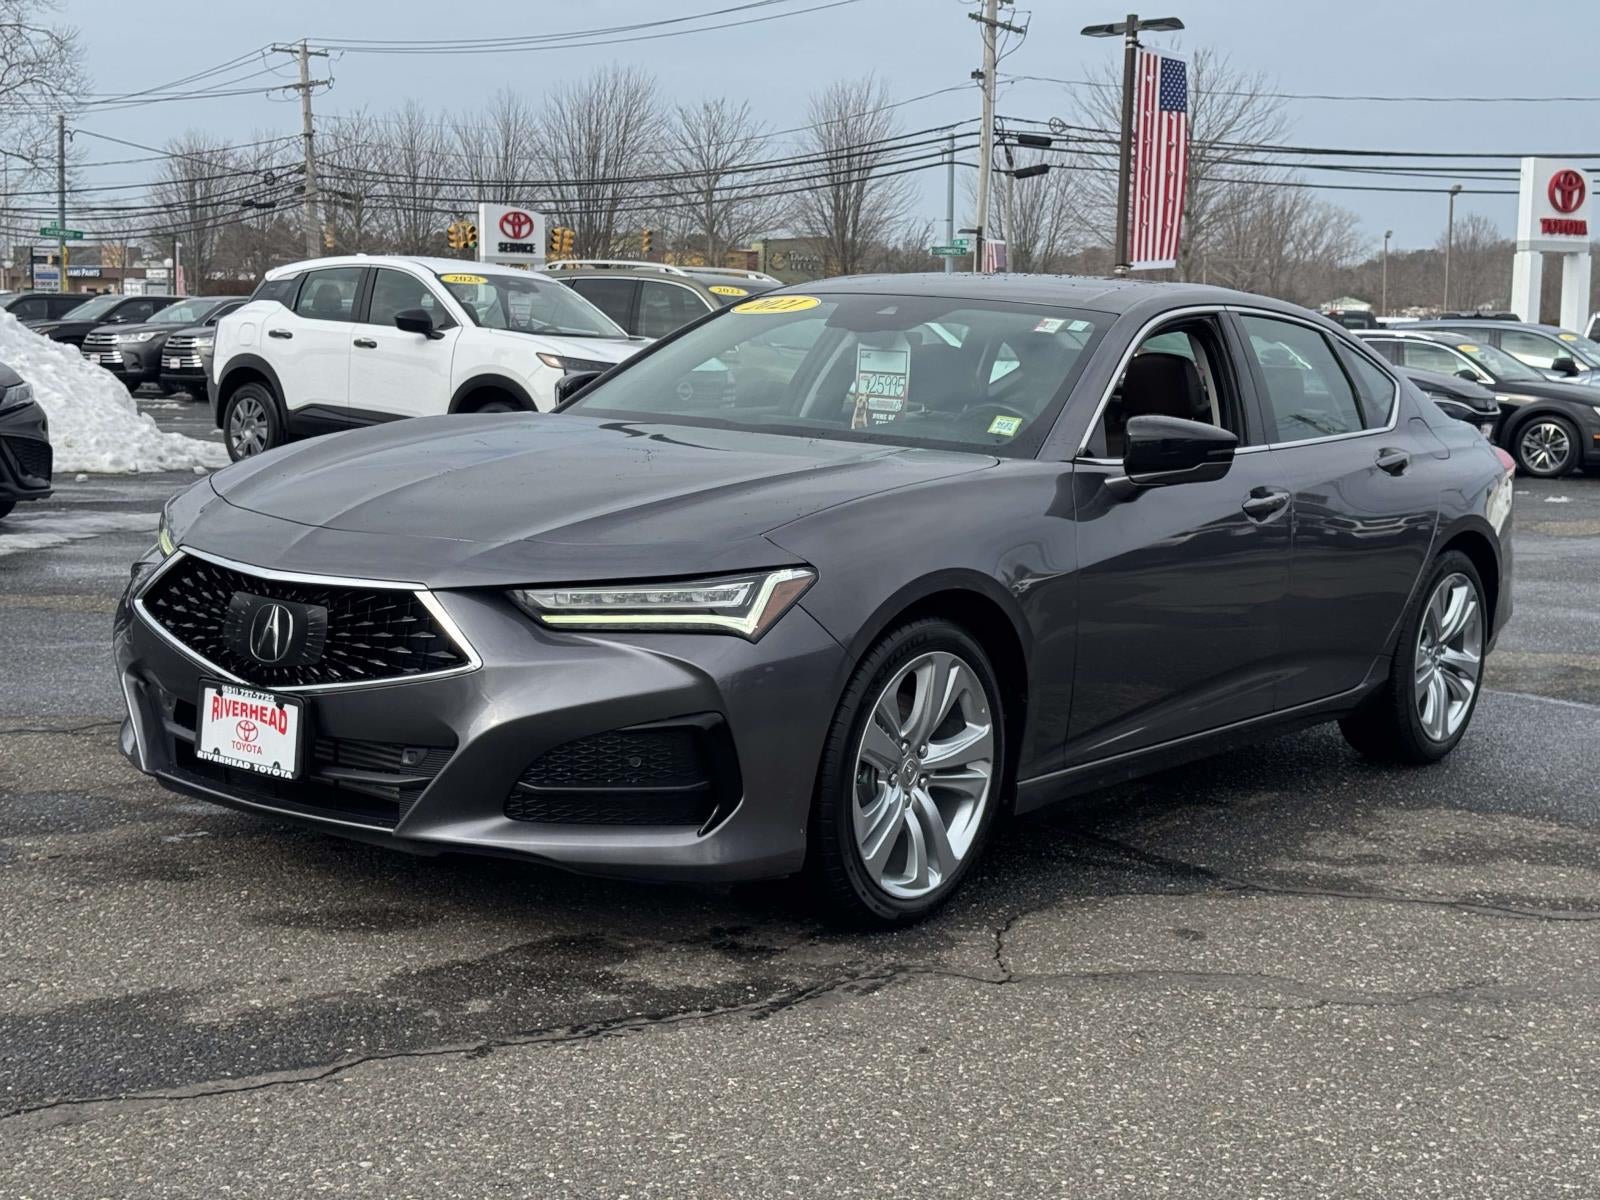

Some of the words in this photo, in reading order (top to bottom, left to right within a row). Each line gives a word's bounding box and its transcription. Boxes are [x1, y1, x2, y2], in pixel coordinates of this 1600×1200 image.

[498, 242, 536, 254] SERVICE
[211, 696, 288, 735] RIVERHEAD
[231, 740, 263, 755] TOYOTA
[196, 750, 251, 769] RIVERHEAD
[253, 763, 293, 779] TOYOTA
